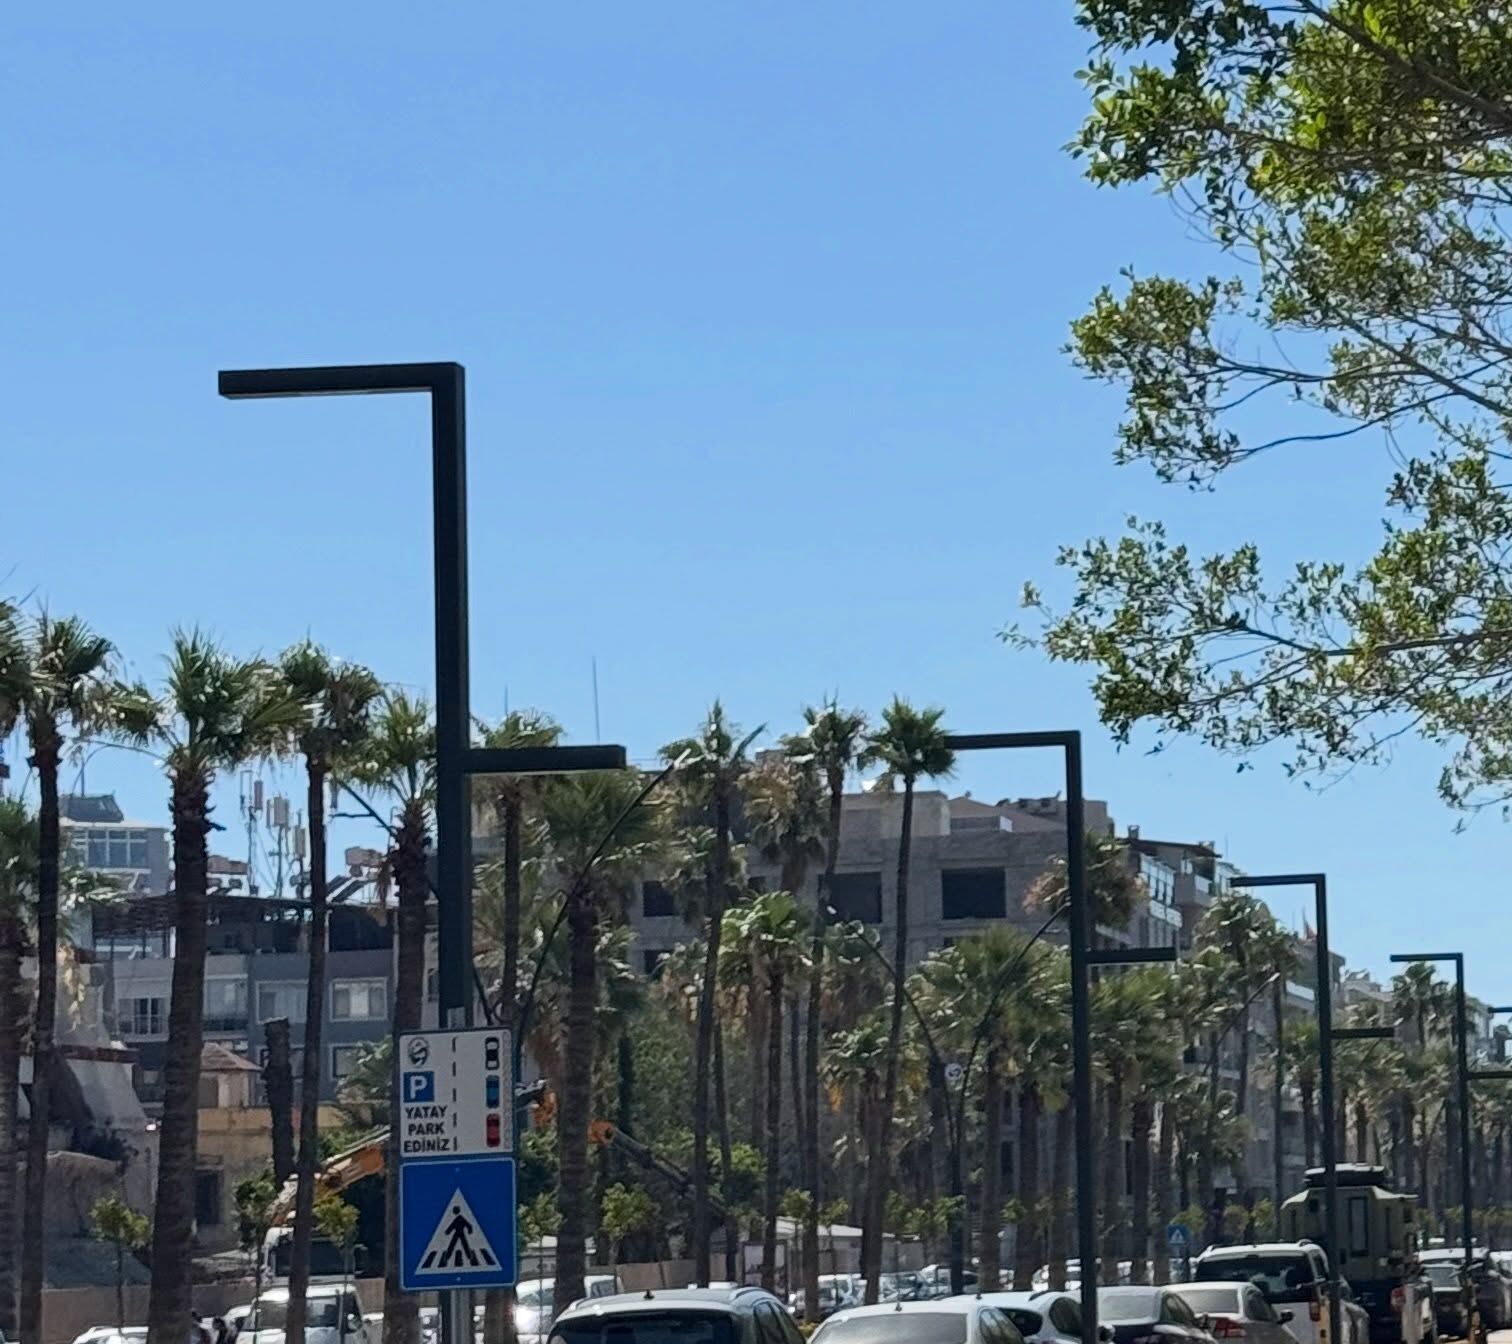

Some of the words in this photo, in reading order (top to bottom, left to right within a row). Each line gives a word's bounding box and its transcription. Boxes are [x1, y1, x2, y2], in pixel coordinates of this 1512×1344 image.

[410, 1075, 428, 1099] P
[405, 1106, 447, 1119] YATAY
[408, 1122, 444, 1135] PARK
[403, 1137, 450, 1153] EDİNİZ
